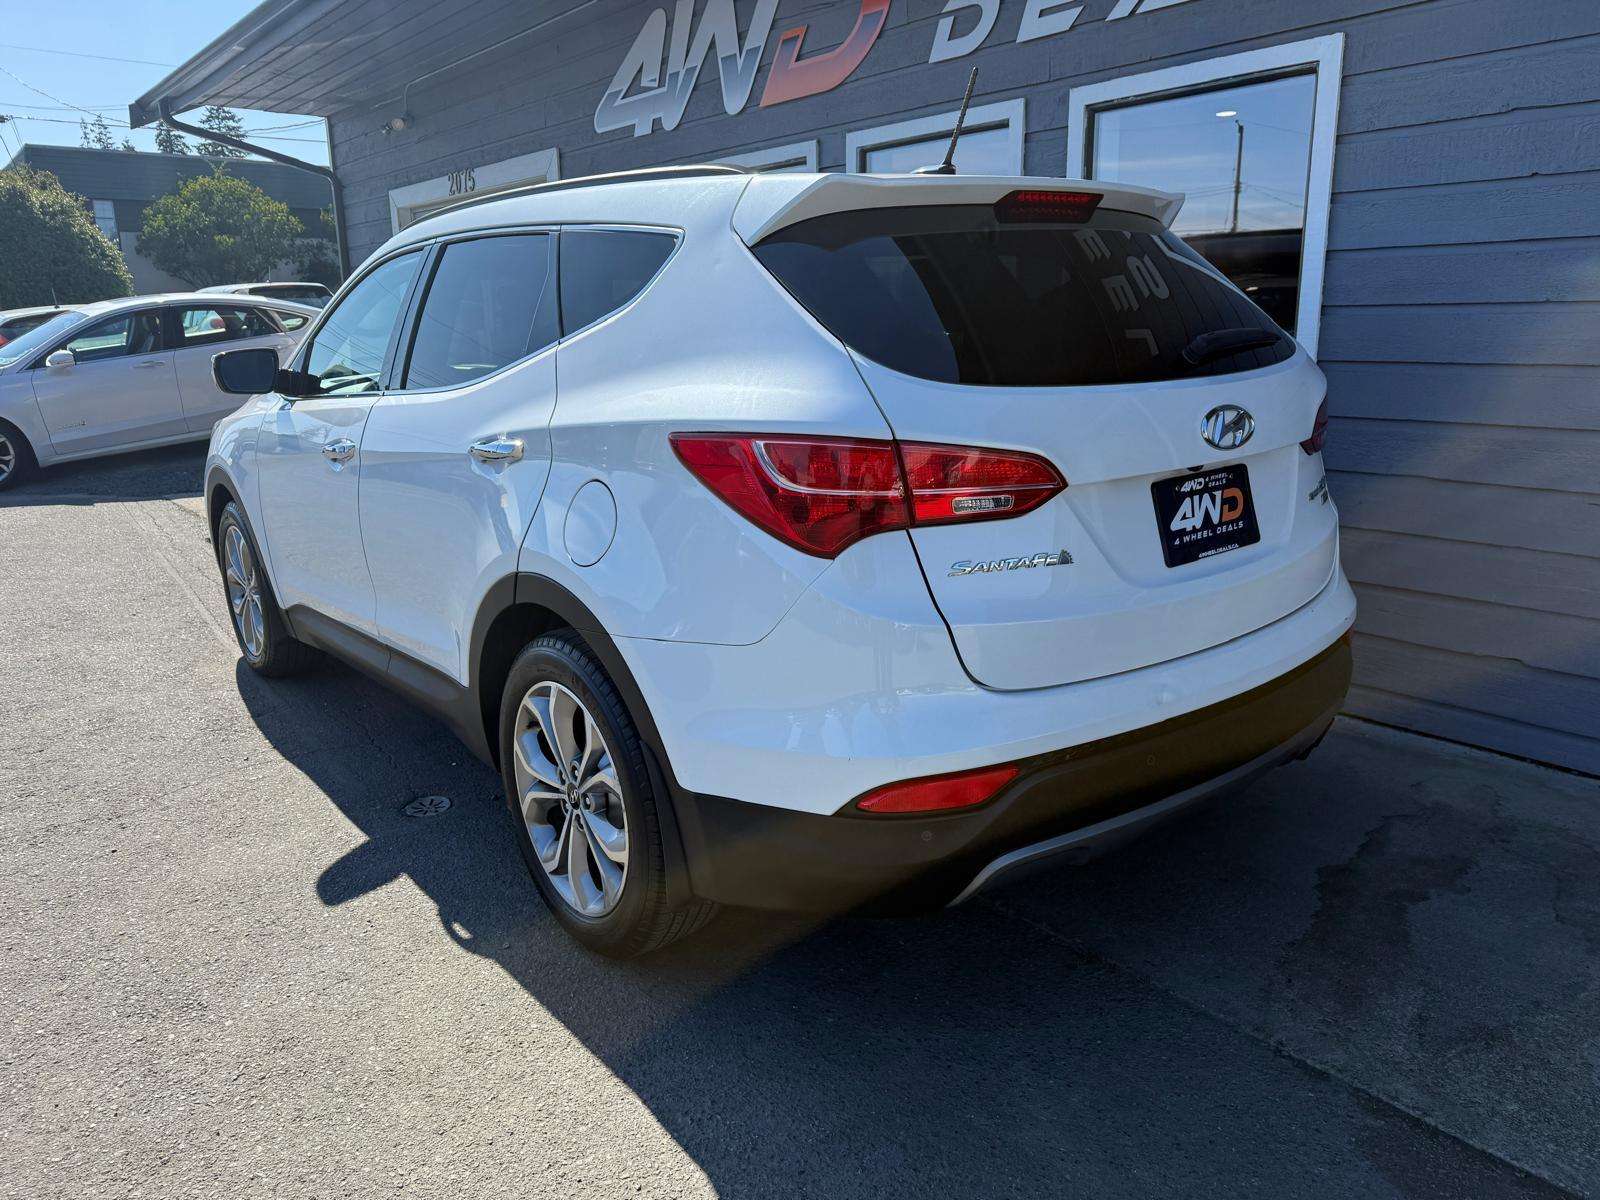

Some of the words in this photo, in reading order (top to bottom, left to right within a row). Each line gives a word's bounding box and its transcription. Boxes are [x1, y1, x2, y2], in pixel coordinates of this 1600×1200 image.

[1170, 487, 1244, 532] 4WD
[1174, 537, 1181, 545] 4
[1183, 529, 1213, 543] WHEEL
[1216, 520, 1245, 534] DEALS
